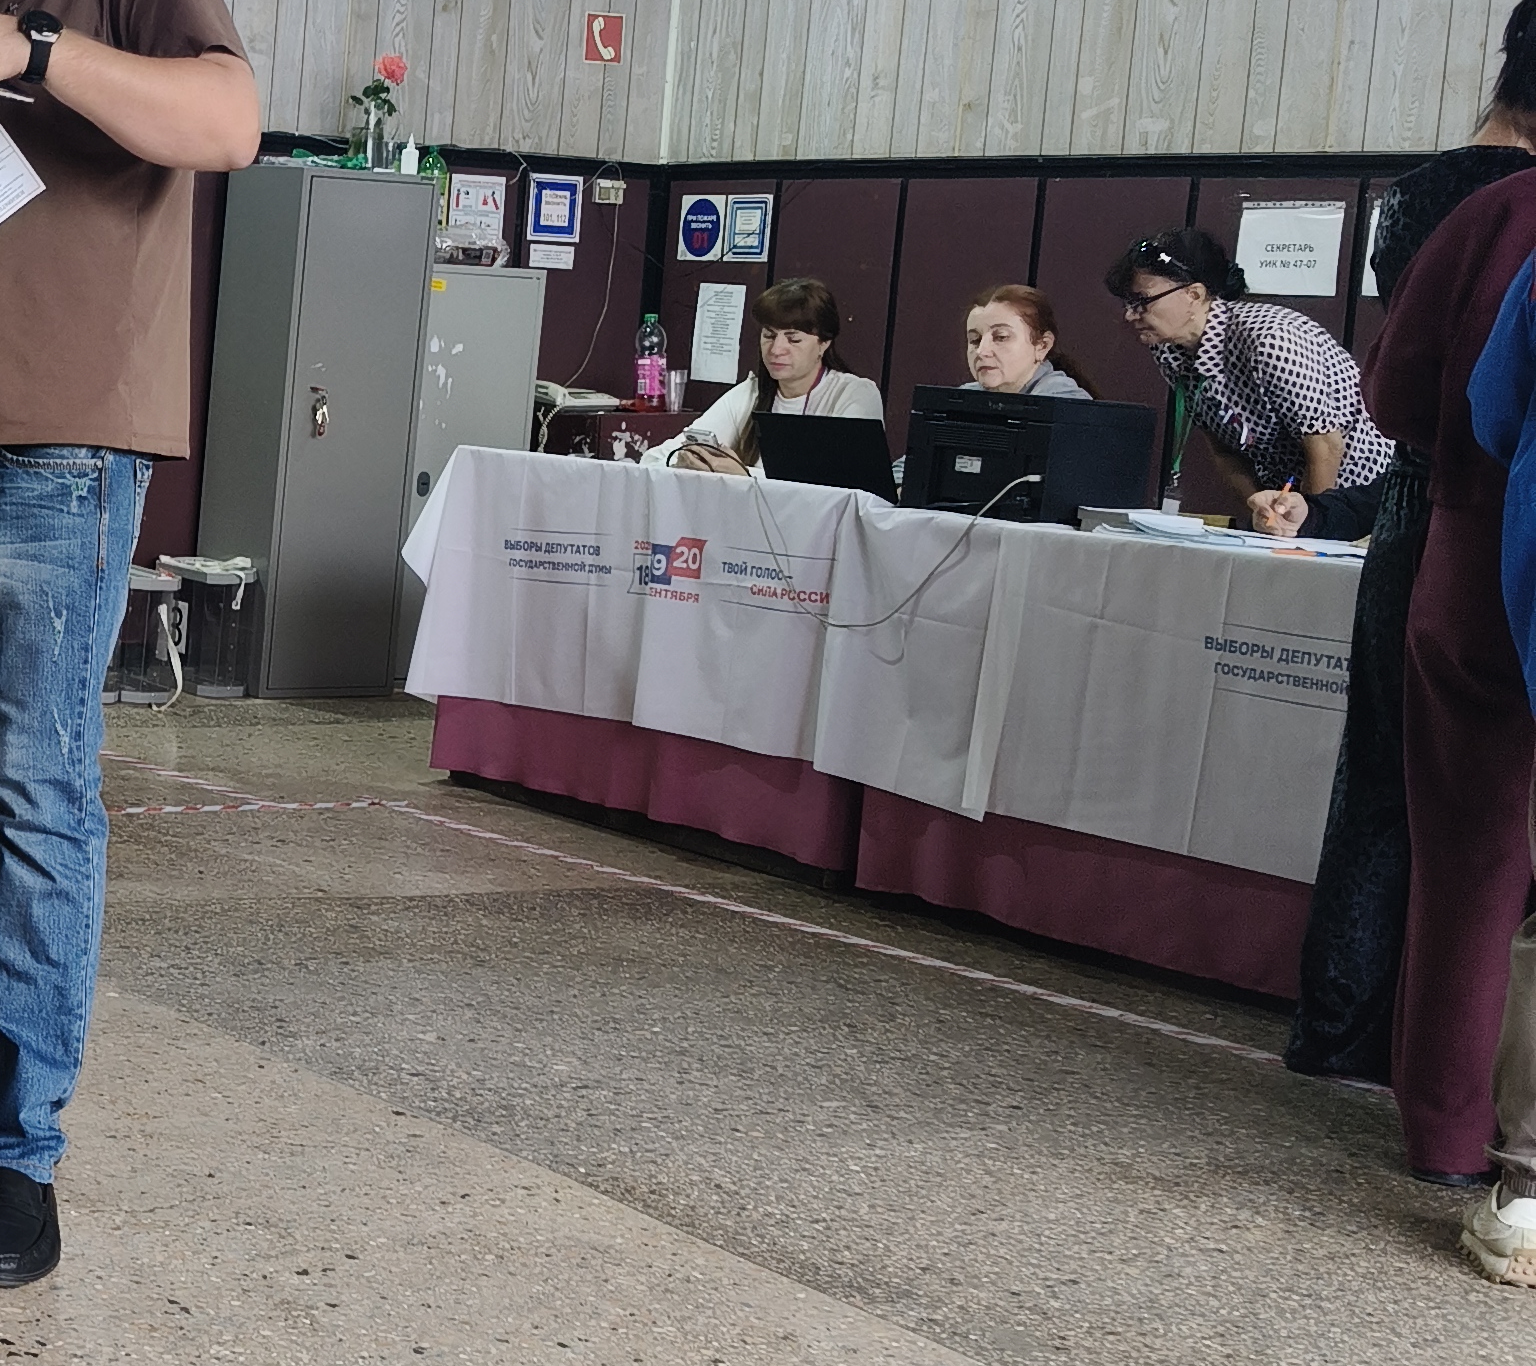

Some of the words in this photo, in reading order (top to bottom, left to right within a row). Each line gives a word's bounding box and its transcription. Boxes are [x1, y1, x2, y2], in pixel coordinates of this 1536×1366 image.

[1264, 243, 1315, 253] СЕКРЕТАРЬ
[1259, 259, 1278, 269] УИК
[1293, 260, 1317, 269] 47-07
[504, 539, 543, 553] ВЫБОРЫ
[543, 542, 601, 557] ДЕПУТАТОВ
[508, 557, 587, 573] ГОСУДАРСТВЕННОЙ
[672, 546, 701, 570] 20
[721, 560, 748, 576] ТВОЙ
[749, 565, 784, 581] ГОЛОС
[648, 586, 700, 604] ЕНТЯБРЯ
[749, 584, 778, 600] СИЛА
[780, 588, 830, 605] РОССИ
[1204, 635, 1275, 660] ВЫБОРЫ
[1277, 647, 1353, 672] ДЕПУТАТ
